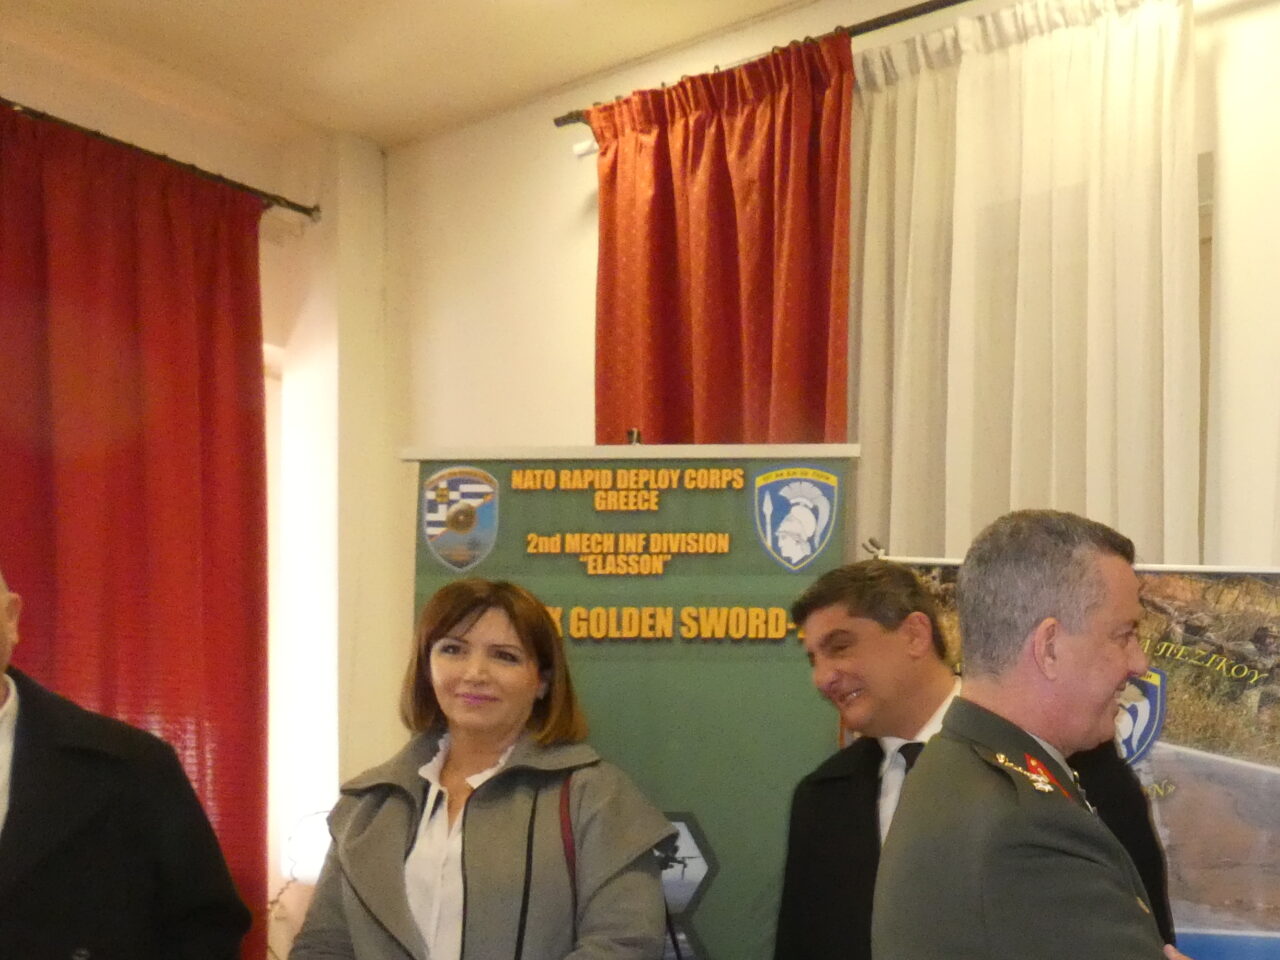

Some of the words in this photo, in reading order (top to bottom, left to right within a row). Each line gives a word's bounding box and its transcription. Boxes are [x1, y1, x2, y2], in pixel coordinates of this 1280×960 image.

[512, 469, 556, 490] NATO
[560, 469, 612, 490] RAPID
[617, 469, 681, 489] DEPLOY
[684, 468, 744, 489] CORPS
[594, 490, 659, 511] GREECE
[527, 533, 561, 553] 2nd
[565, 533, 614, 553] MECH
[619, 533, 646, 553] INF
[650, 533, 729, 553] DIVISION
[569, 606, 674, 639] GOLDEN
[680, 606, 806, 639] SWORD-
[1154, 640, 1269, 684] ΠΕΖΙΚΟΥ
